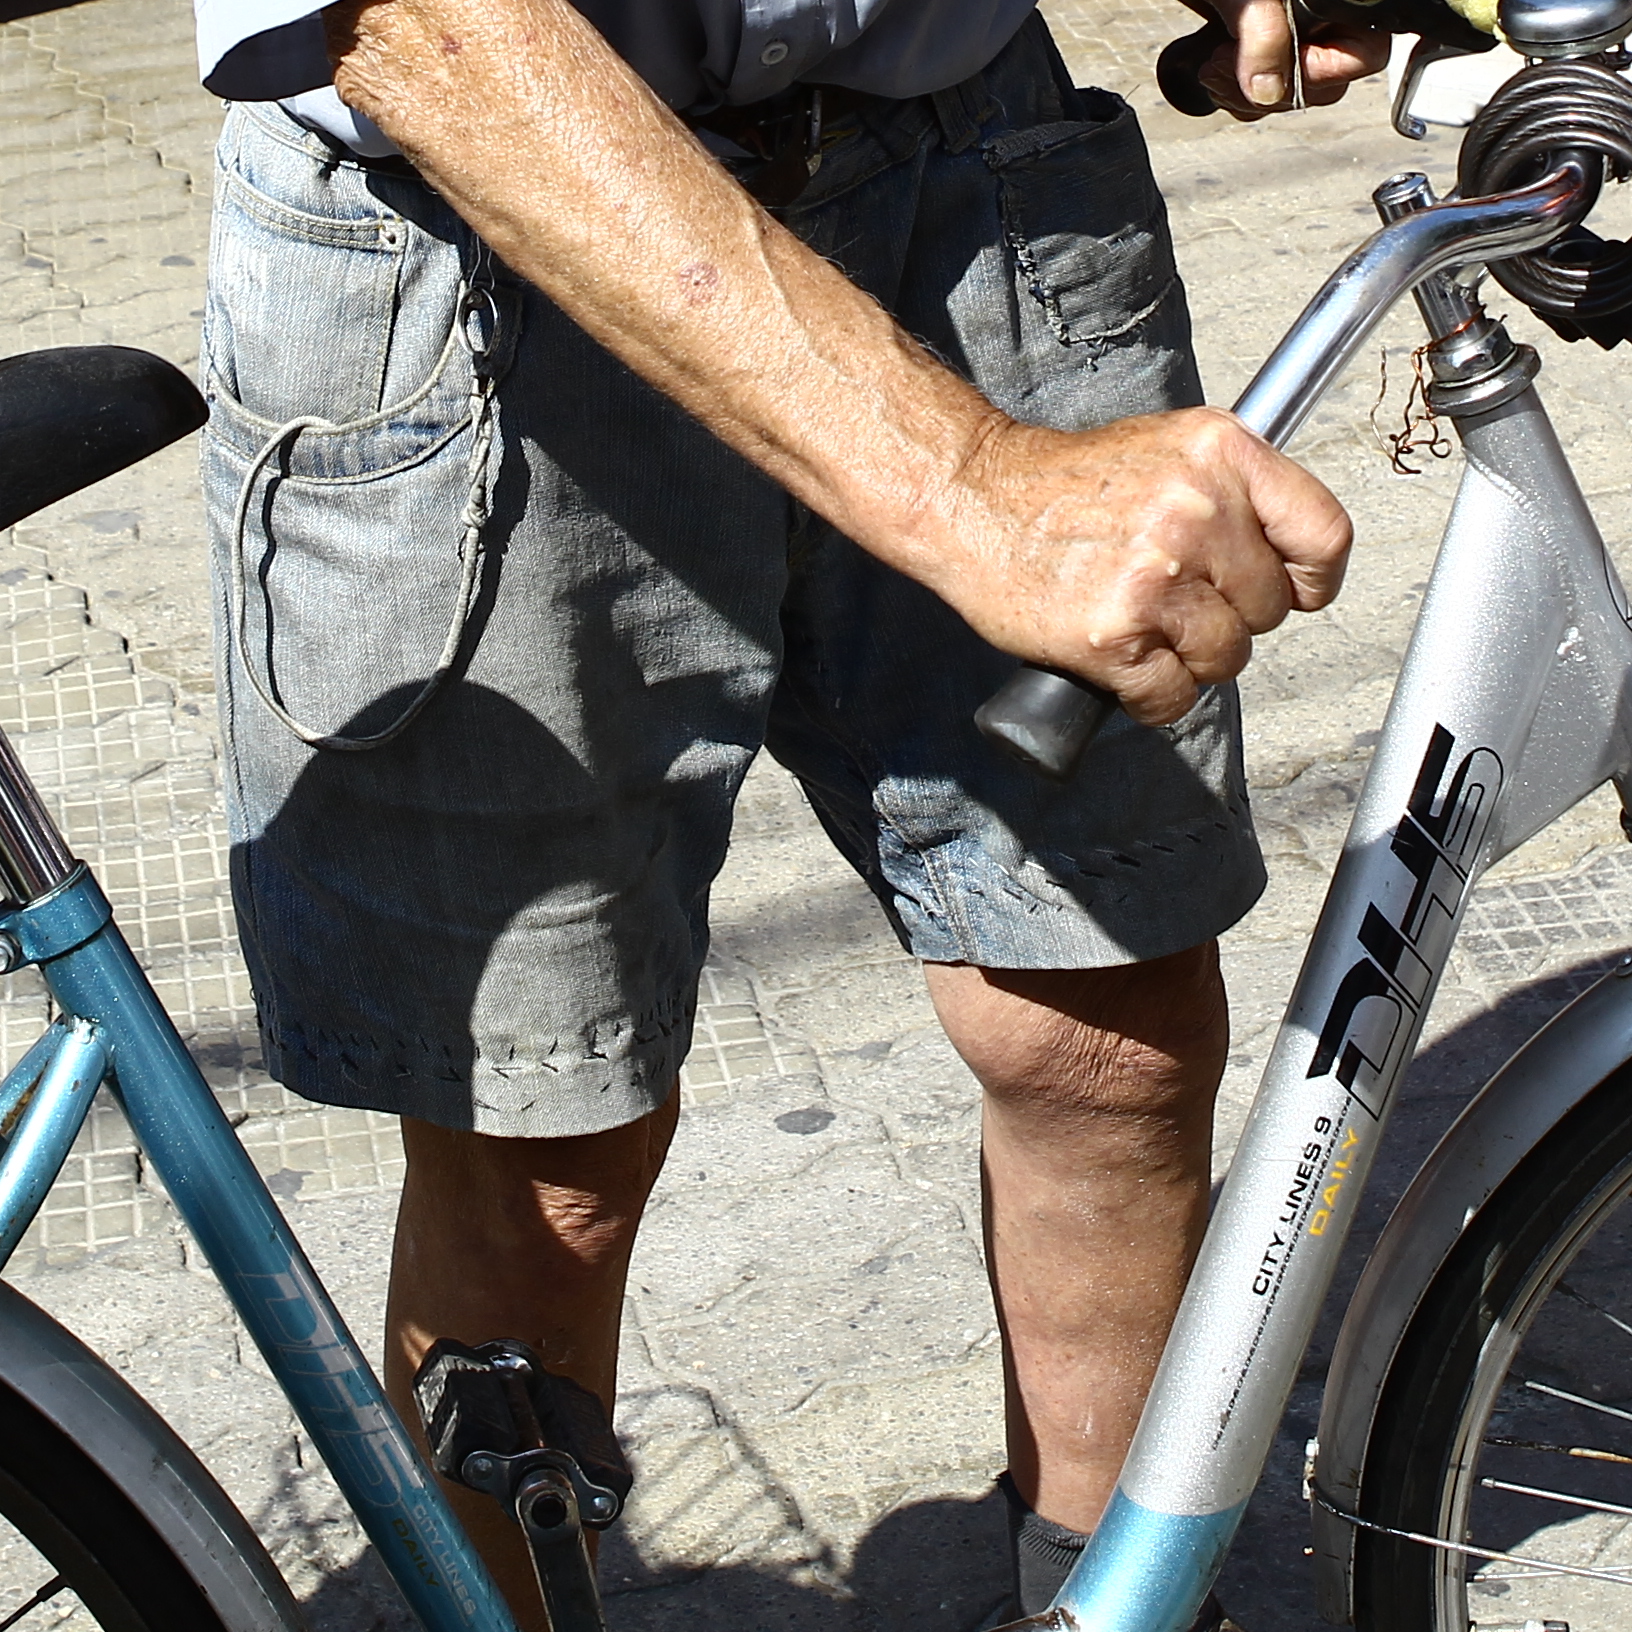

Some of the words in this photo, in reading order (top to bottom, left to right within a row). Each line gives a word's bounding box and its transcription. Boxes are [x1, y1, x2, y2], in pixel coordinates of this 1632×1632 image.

[1305, 721, 1505, 1123] DHS
[1252, 1231, 1285, 1297] CITY
[1279, 1142, 1322, 1226] LINES
[1314, 1115, 1332, 1136] 9
[1308, 1126, 1360, 1236] DAILY
[391, 1518, 441, 1590] DAILY
[412, 1503, 446, 1549] CITY
[440, 1545, 477, 1617] LINES
